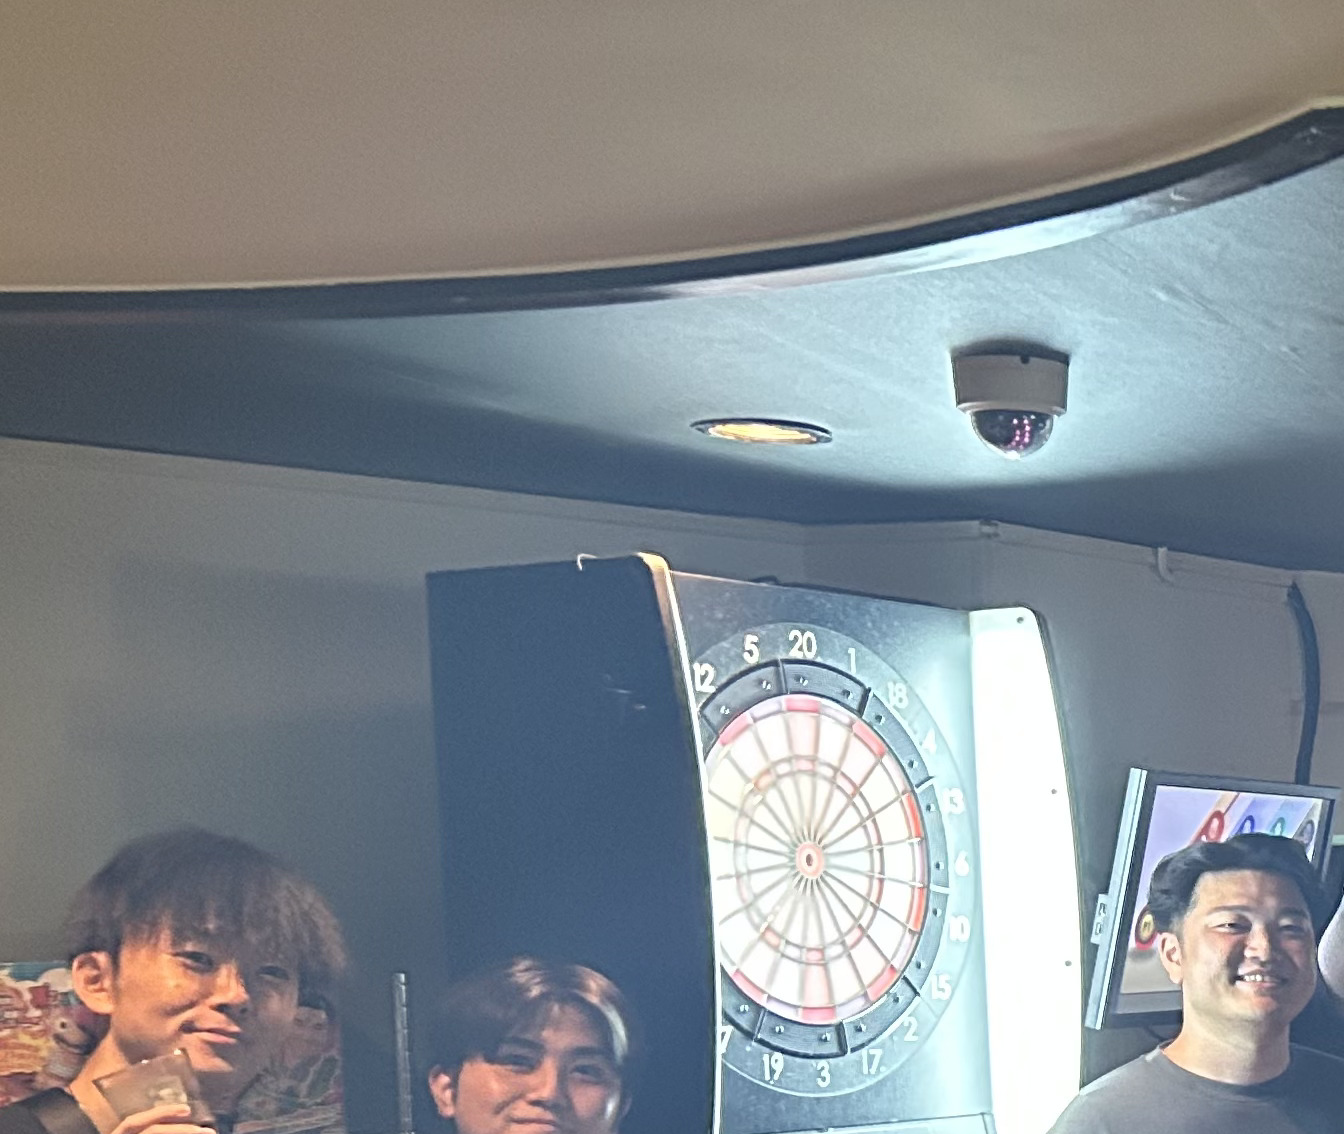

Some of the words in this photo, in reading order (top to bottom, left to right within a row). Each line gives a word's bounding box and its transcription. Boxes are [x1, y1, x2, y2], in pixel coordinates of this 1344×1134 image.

[743, 634, 760, 664] 5
[788, 630, 818, 659] 20
[847, 648, 858, 673] 1
[693, 663, 716, 693] 12
[889, 682, 908, 708] 18
[944, 788, 965, 813] 13
[955, 851, 969, 876] 6
[950, 915, 969, 941] 10
[932, 975, 951, 1000] 15
[904, 1018, 918, 1041] 2
[764, 1054, 783, 1080] 19
[817, 1062, 830, 1087] 3
[862, 1050, 880, 1074] 17
